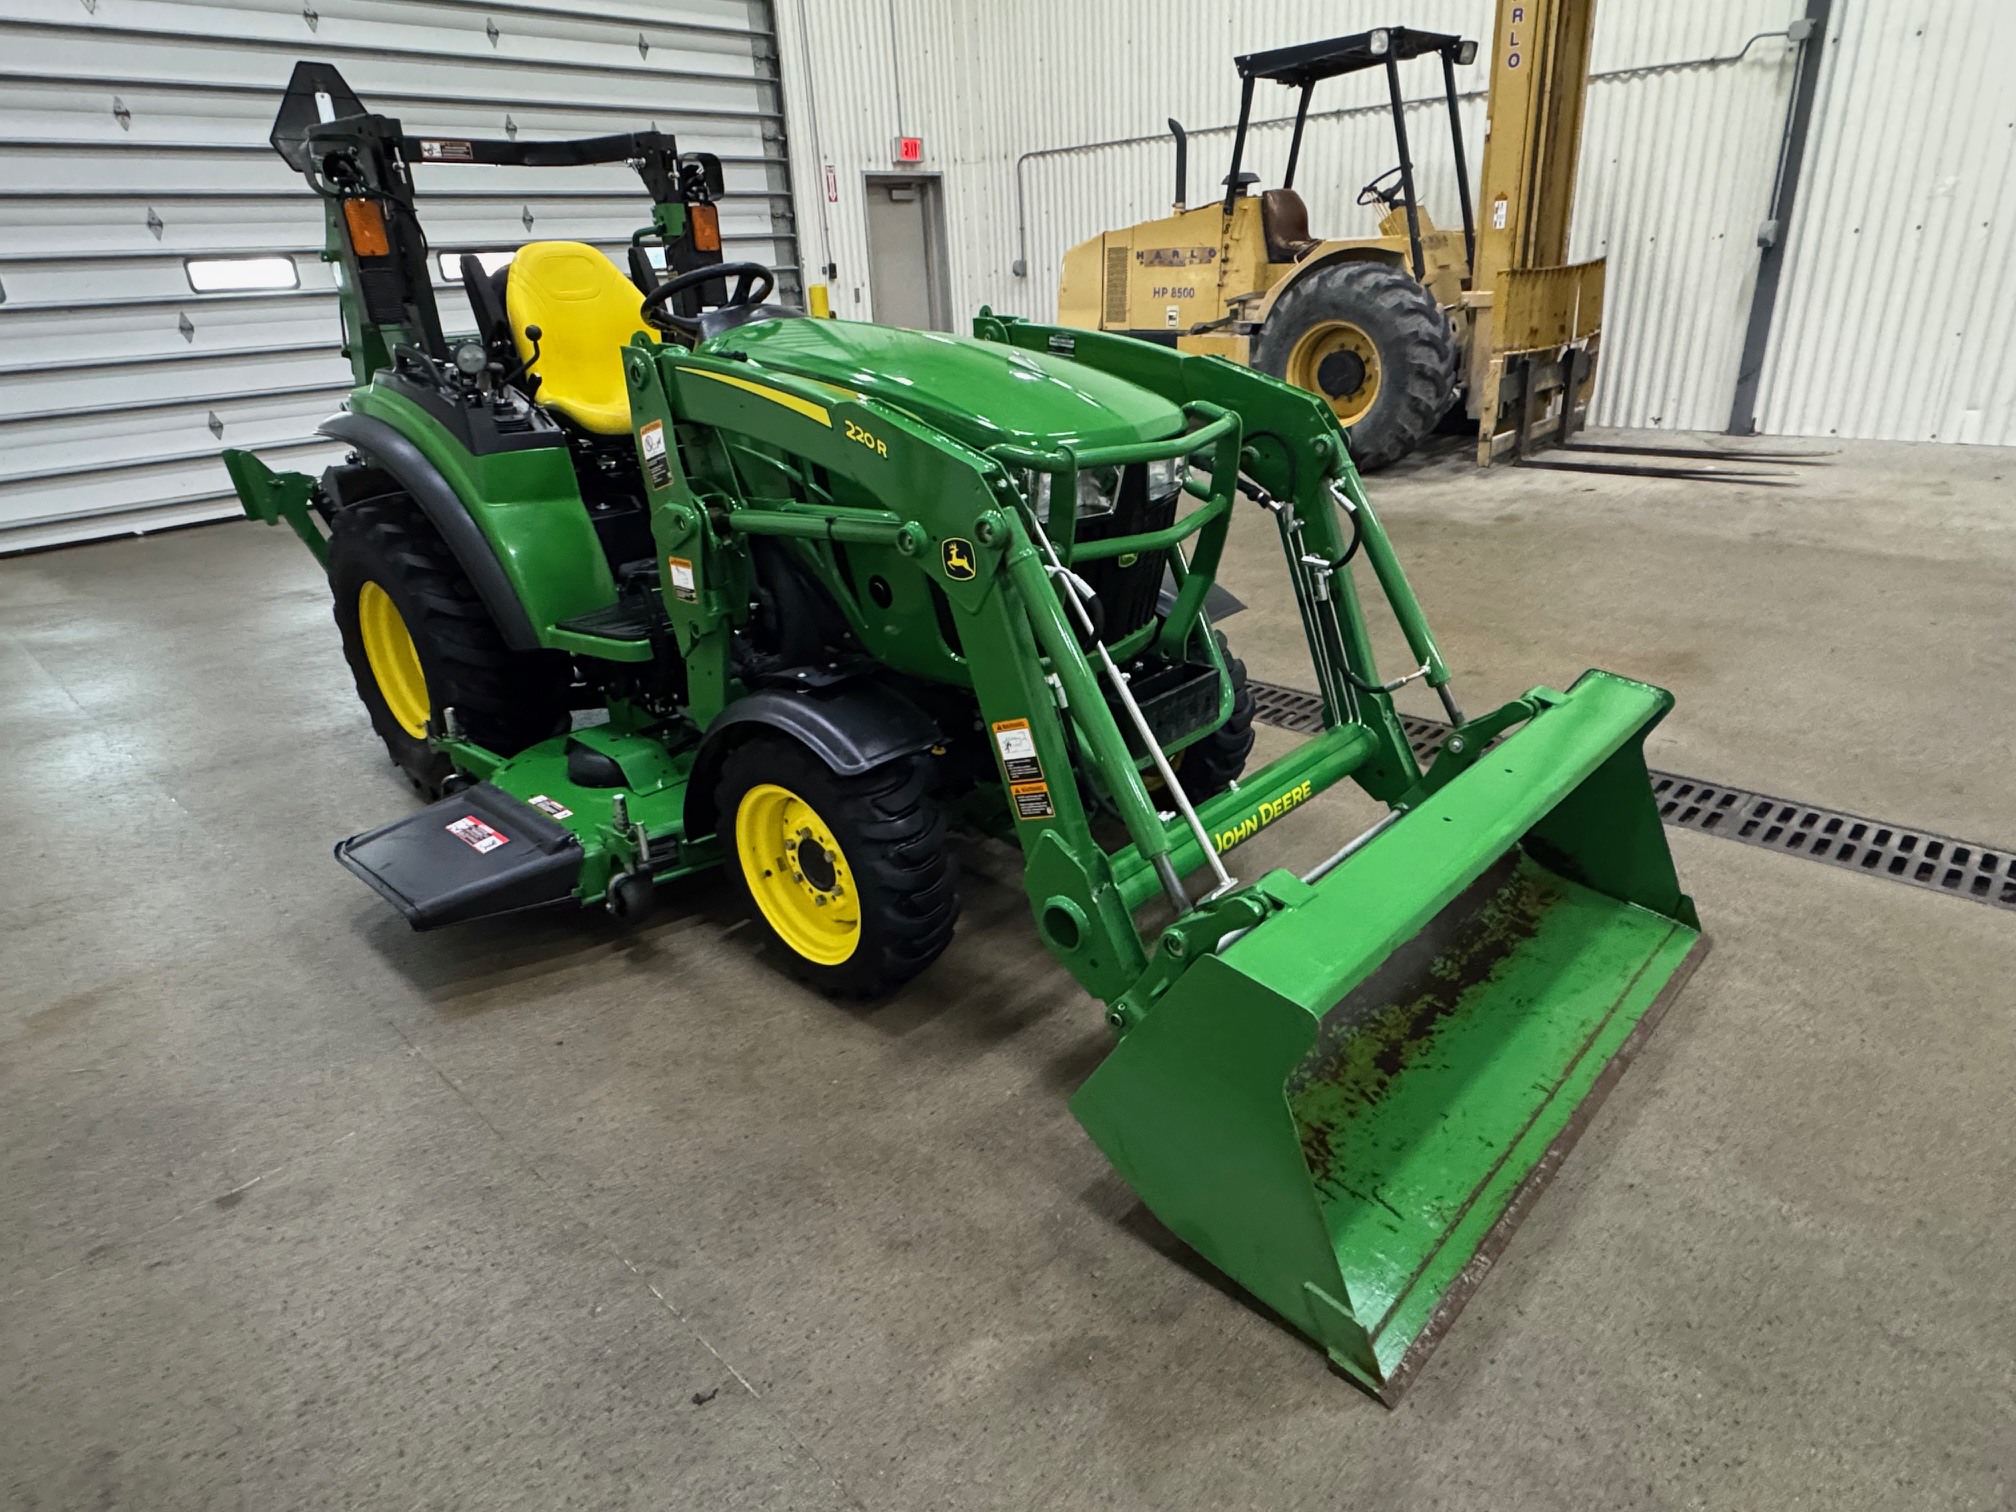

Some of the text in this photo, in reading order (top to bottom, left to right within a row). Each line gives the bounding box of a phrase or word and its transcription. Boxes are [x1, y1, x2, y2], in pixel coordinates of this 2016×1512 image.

[1508, 0, 1523, 68] RLO
[1136, 248, 1216, 260] HARLO
[1153, 287, 1195, 298] HP 8500
[1215, 780, 1312, 854] JOHN DEERE
